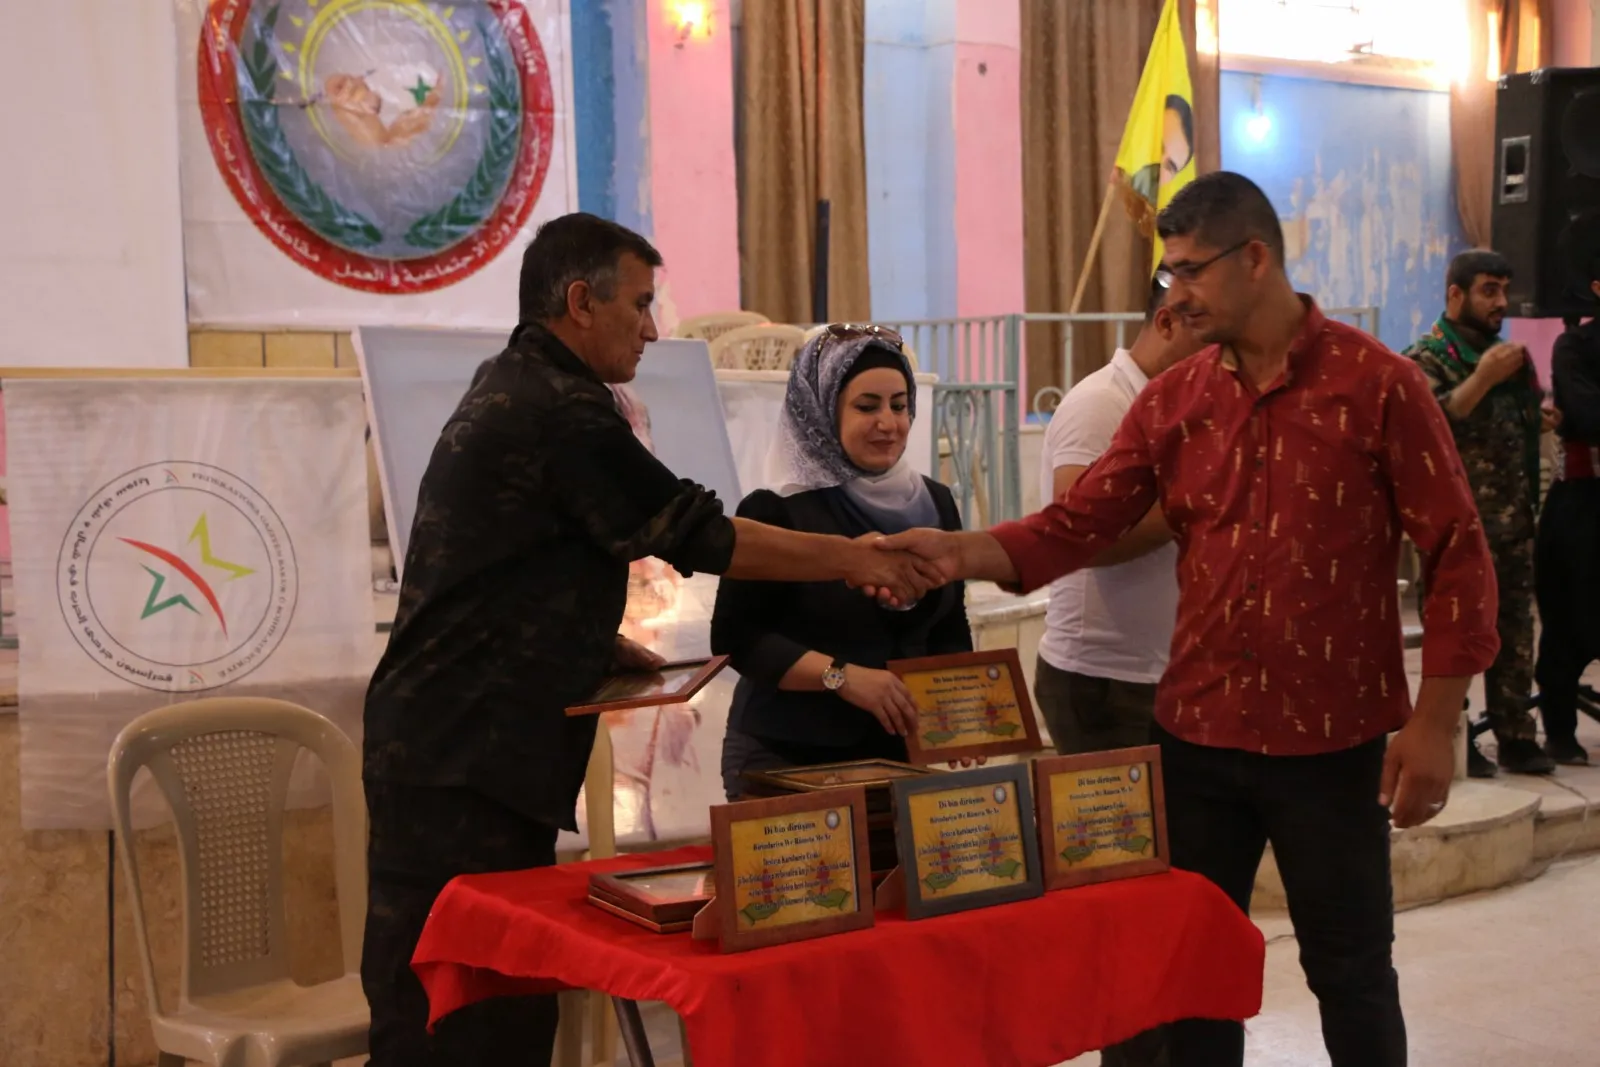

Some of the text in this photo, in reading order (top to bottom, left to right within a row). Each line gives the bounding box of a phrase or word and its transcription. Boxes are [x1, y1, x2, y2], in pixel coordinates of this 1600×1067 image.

[334, 261, 385, 282] العمل
[116, 477, 150, 497] سوريا
[764, 825, 774, 836] Di
